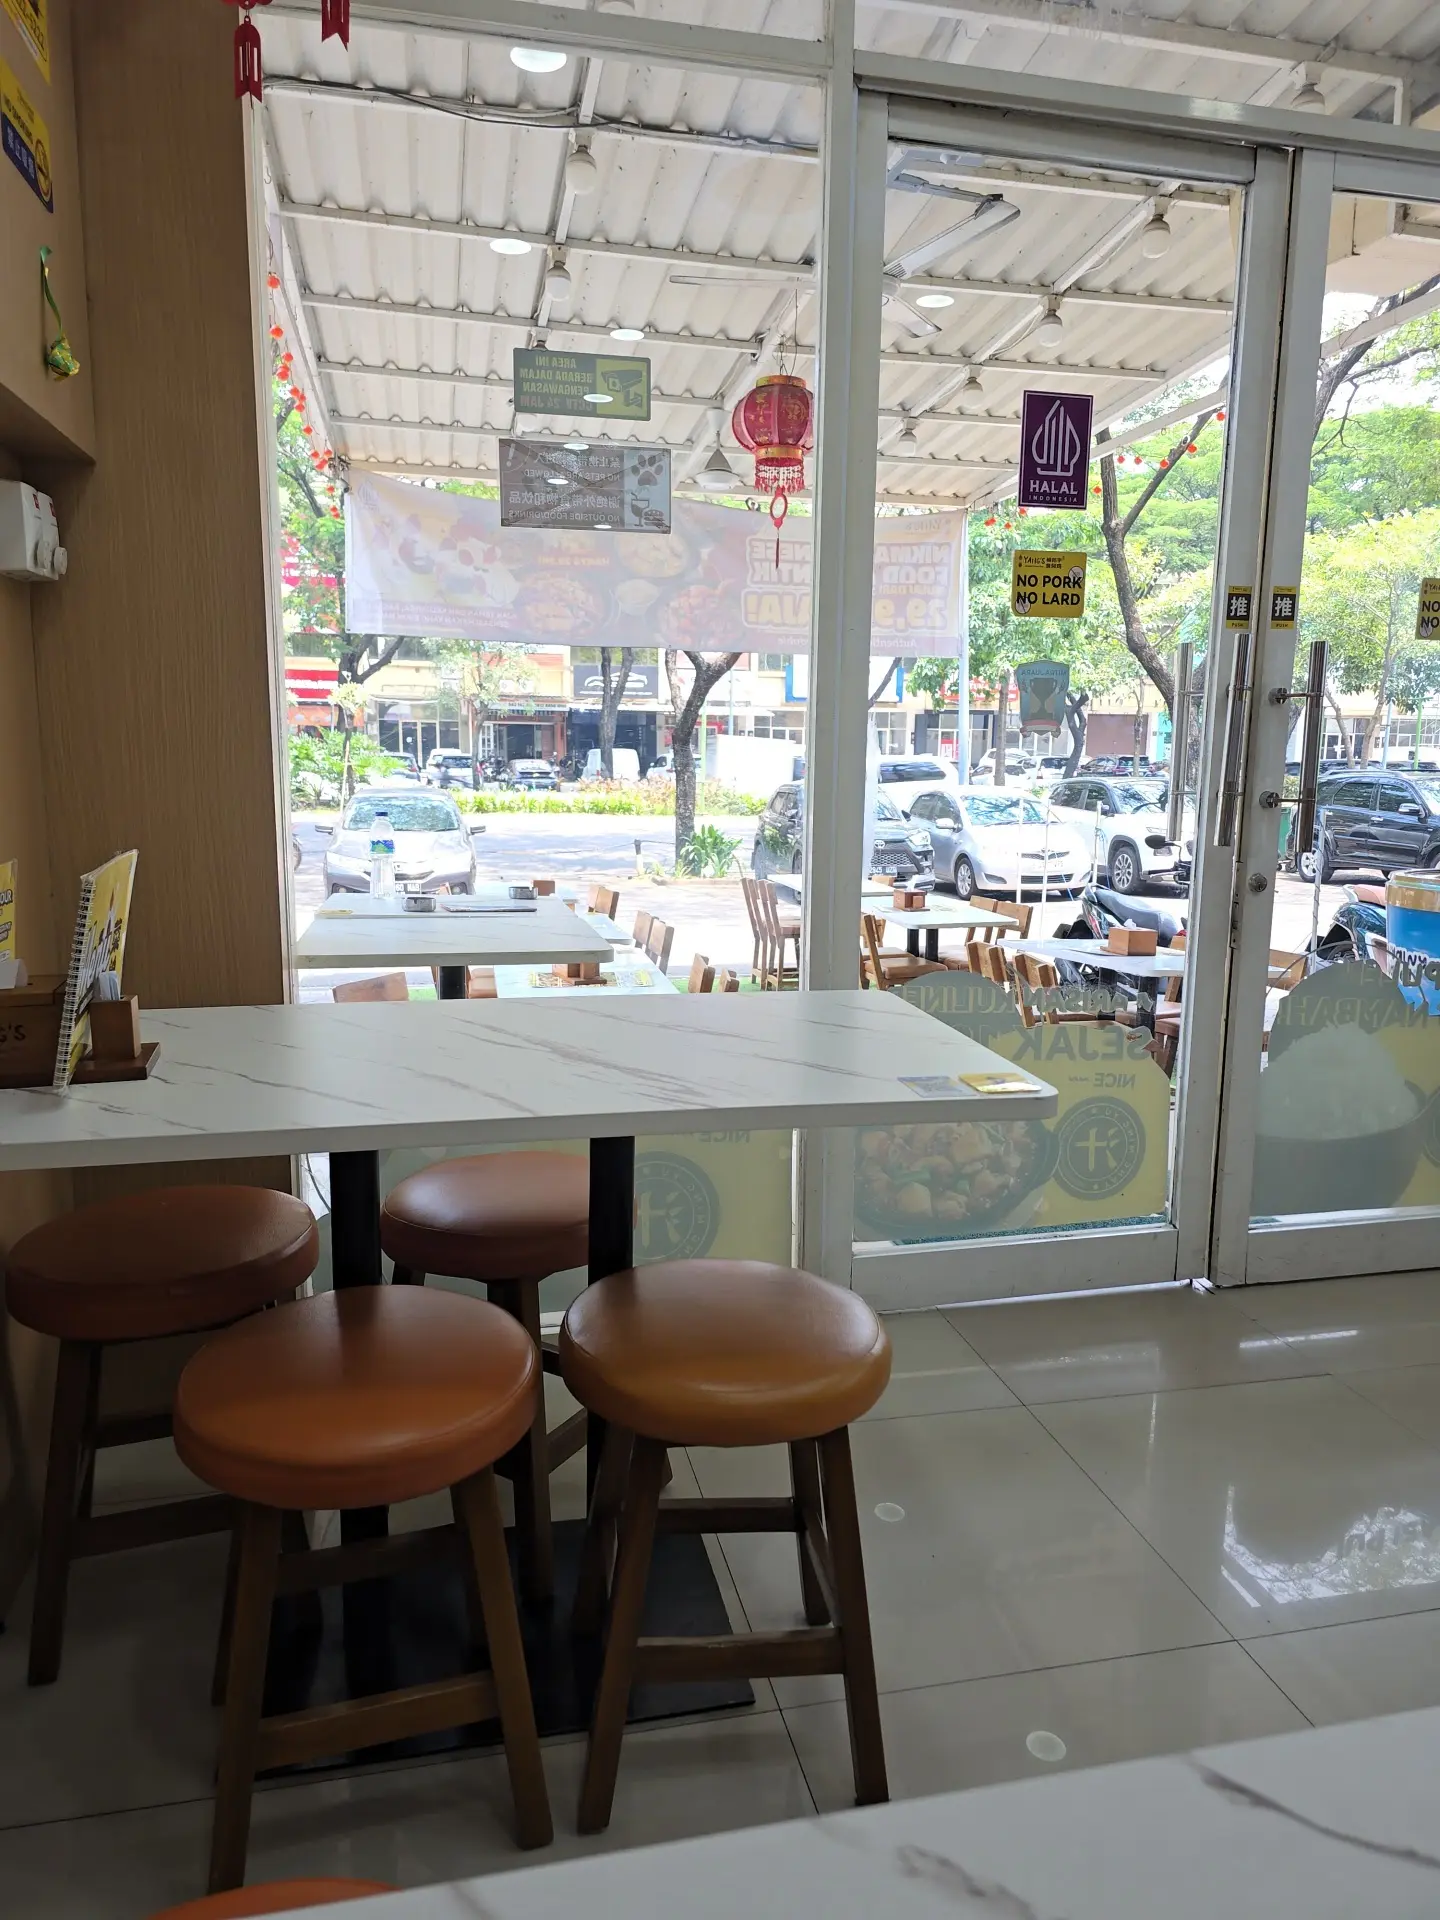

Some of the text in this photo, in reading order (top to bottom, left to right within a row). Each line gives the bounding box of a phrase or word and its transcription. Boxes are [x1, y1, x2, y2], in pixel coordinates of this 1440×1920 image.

[1029, 479, 1078, 495] HALAL
[1028, 495, 1078, 503] INDONESIA
[1017, 574, 1083, 589] NO PORK
[1016, 591, 1081, 605] NO LARD
[1230, 596, 1248, 617] 推
[1274, 596, 1293, 617] 推
[1422, 600, 1440, 613] NO
[1421, 616, 1440, 628] NO
